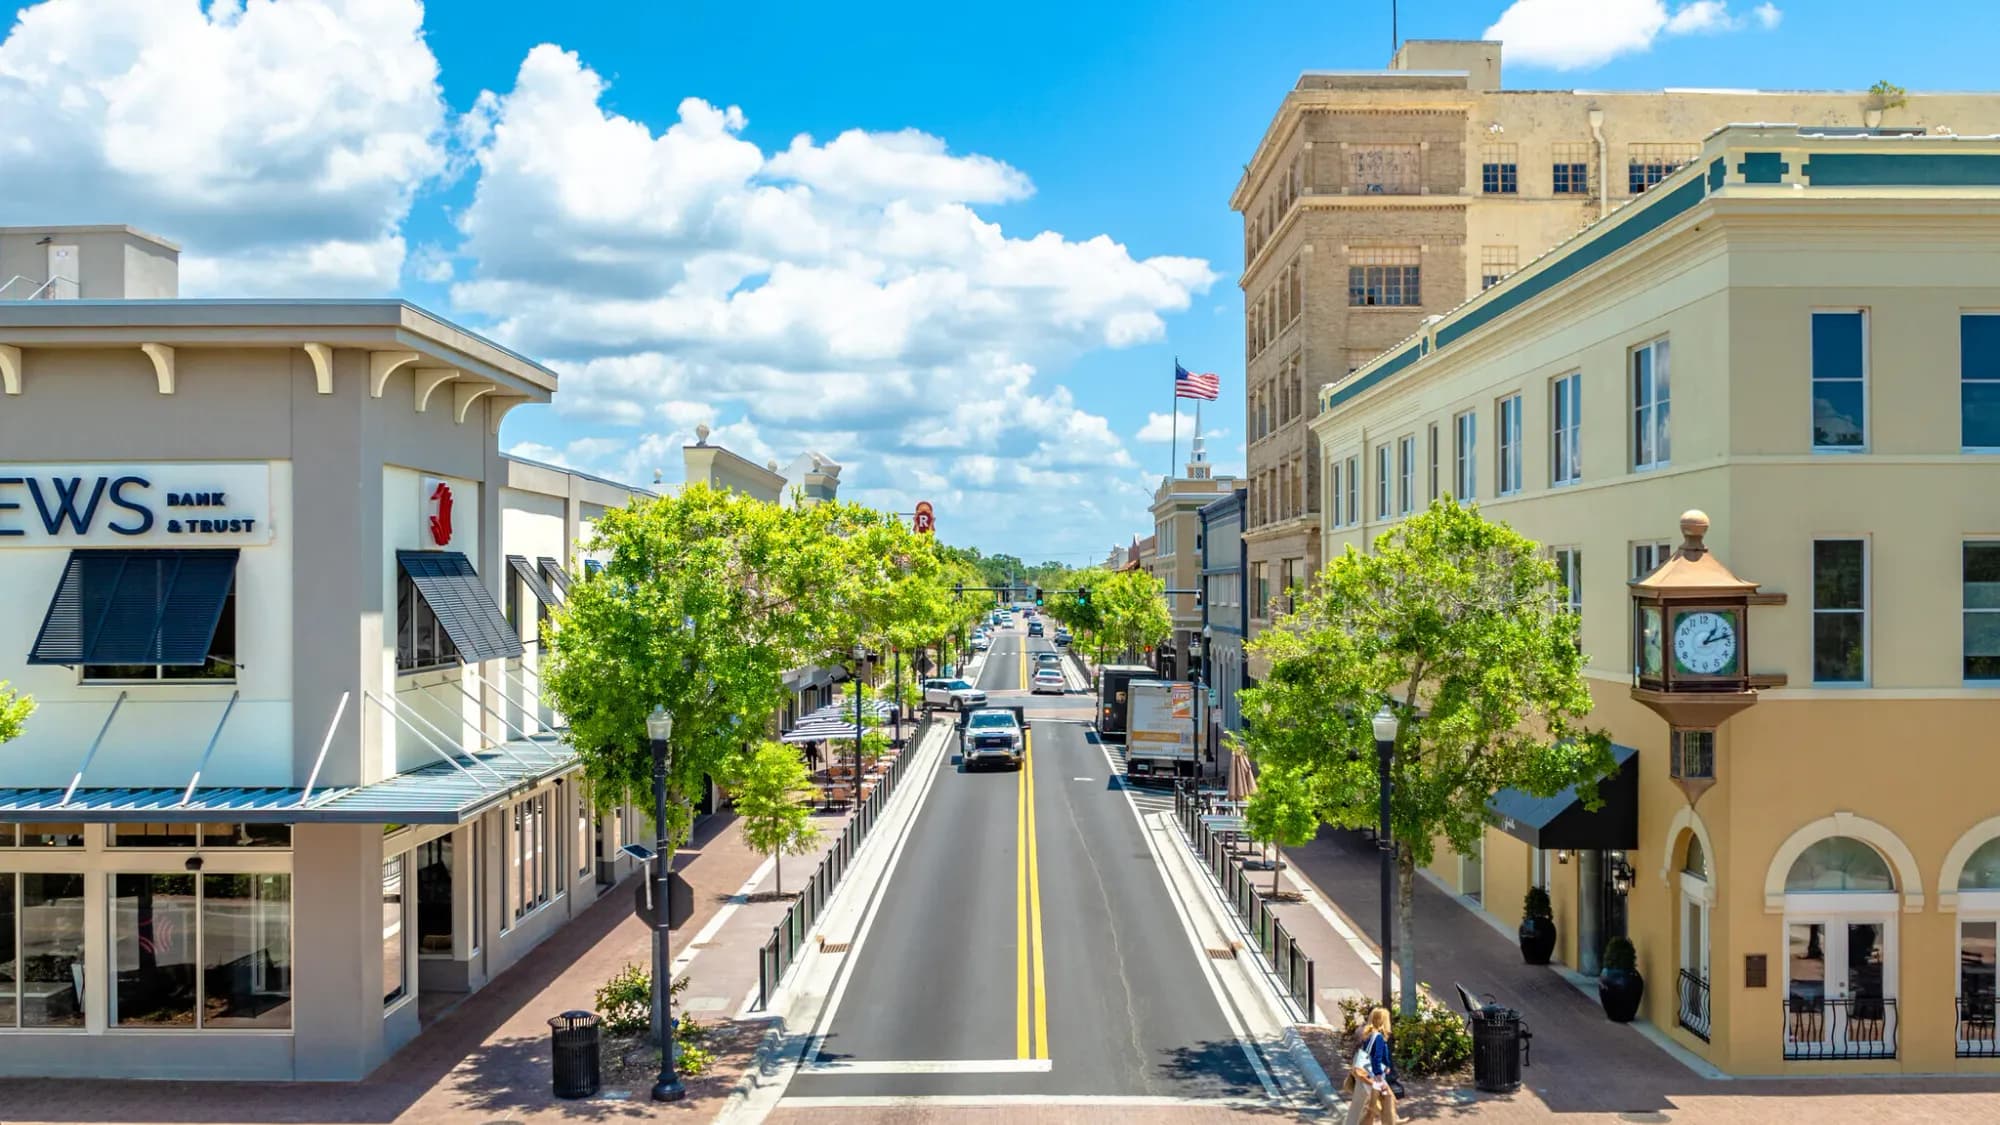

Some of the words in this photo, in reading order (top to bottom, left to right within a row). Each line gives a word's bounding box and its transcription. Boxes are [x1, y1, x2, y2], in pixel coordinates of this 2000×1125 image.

[167, 492, 226, 507] BANK
[167, 519, 183, 533] &
[186, 519, 256, 533] TRUST
[919, 514, 929, 528] R
[1690, 618, 1696, 628] 11
[1700, 615, 1709, 625] 12
[1681, 627, 1690, 636] 10
[1679, 639, 1685, 649] 9
[1682, 651, 1688, 660] 8
[1722, 650, 1729, 659] 4
[1713, 658, 1720, 668] 5
